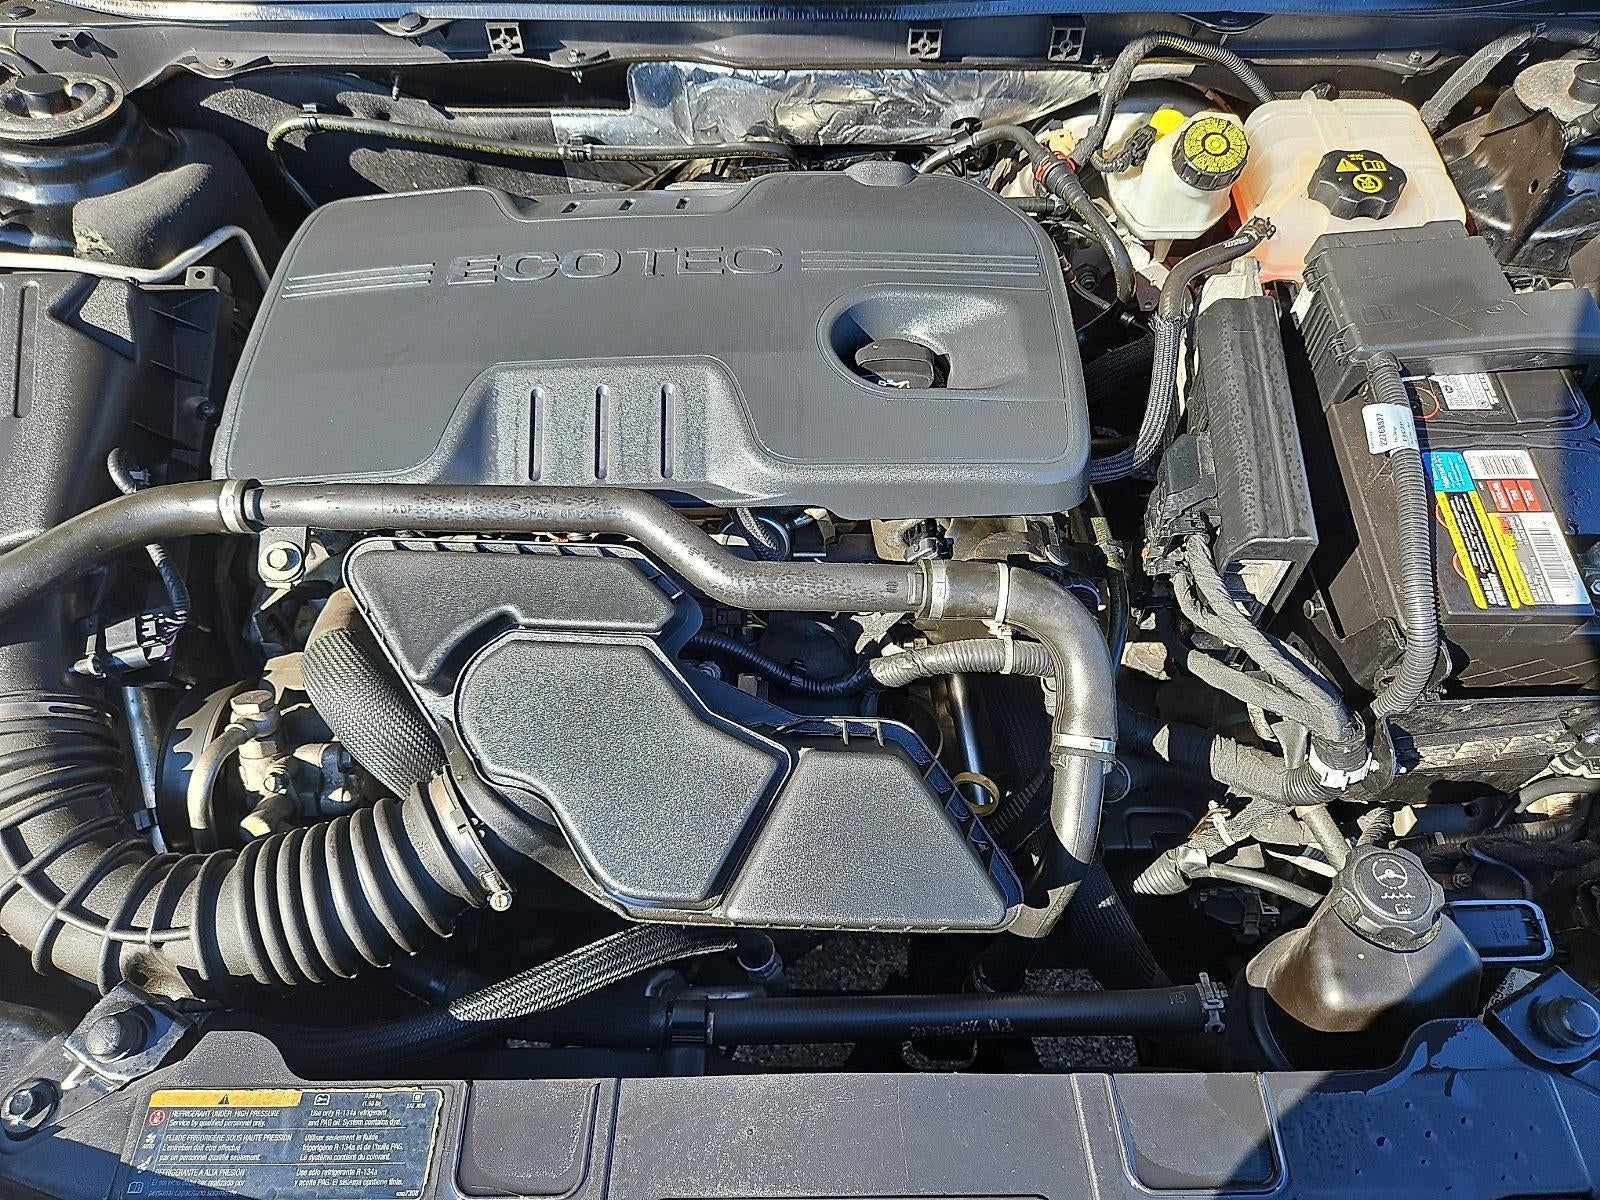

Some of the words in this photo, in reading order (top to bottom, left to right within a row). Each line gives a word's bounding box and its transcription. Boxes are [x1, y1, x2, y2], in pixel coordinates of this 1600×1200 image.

[448, 246, 783, 286] ECOTEC
[334, 1143, 355, 1151] R-134a
[356, 1143, 363, 1151] et
[364, 1143, 371, 1151] de
[204, 1168, 219, 1176] ALTA
